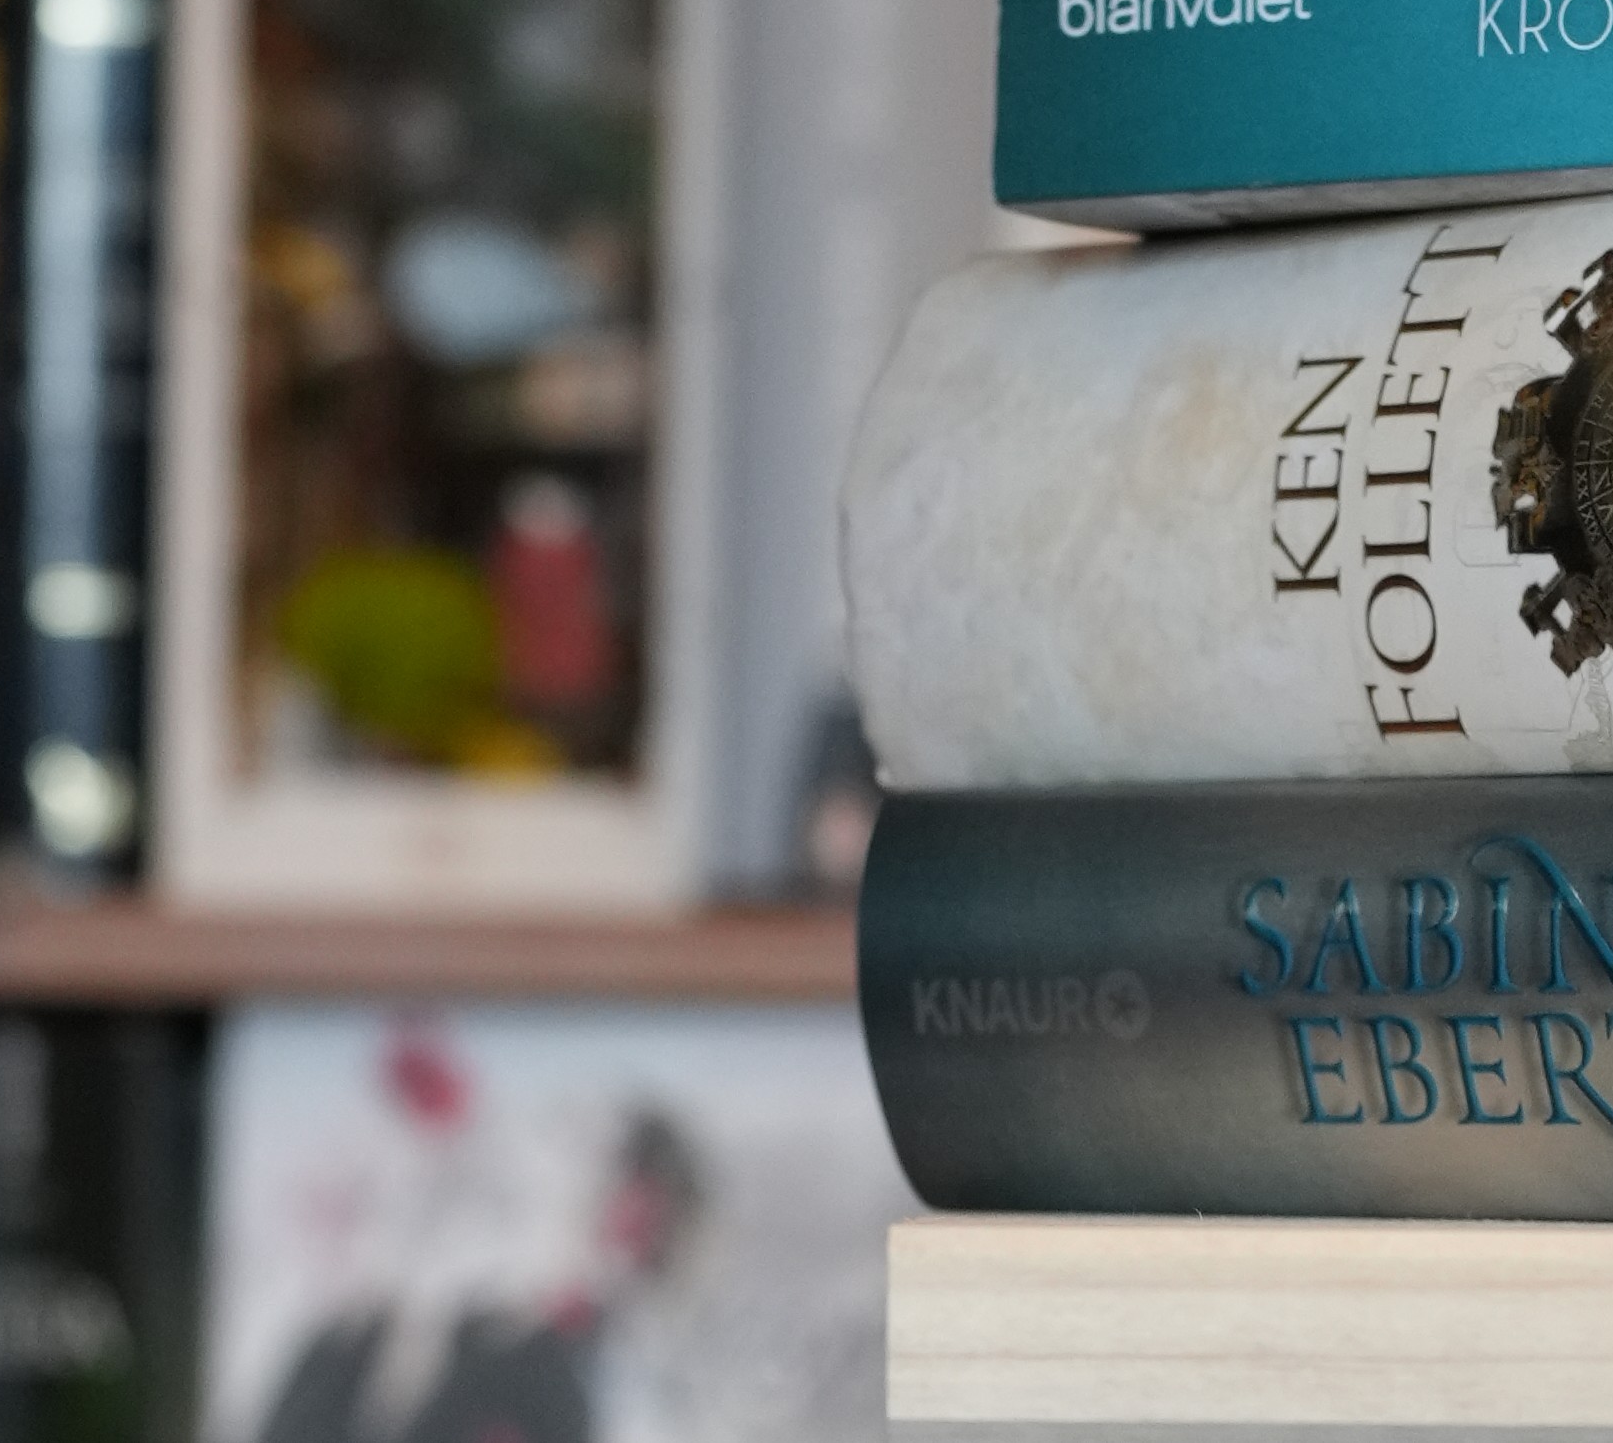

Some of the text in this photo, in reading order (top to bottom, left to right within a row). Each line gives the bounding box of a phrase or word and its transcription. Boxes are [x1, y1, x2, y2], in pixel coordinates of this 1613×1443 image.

[1270, 354, 1366, 603] KEN
[1362, 223, 1514, 744] FOLLETT
[911, 975, 1094, 1039] KNAUR
